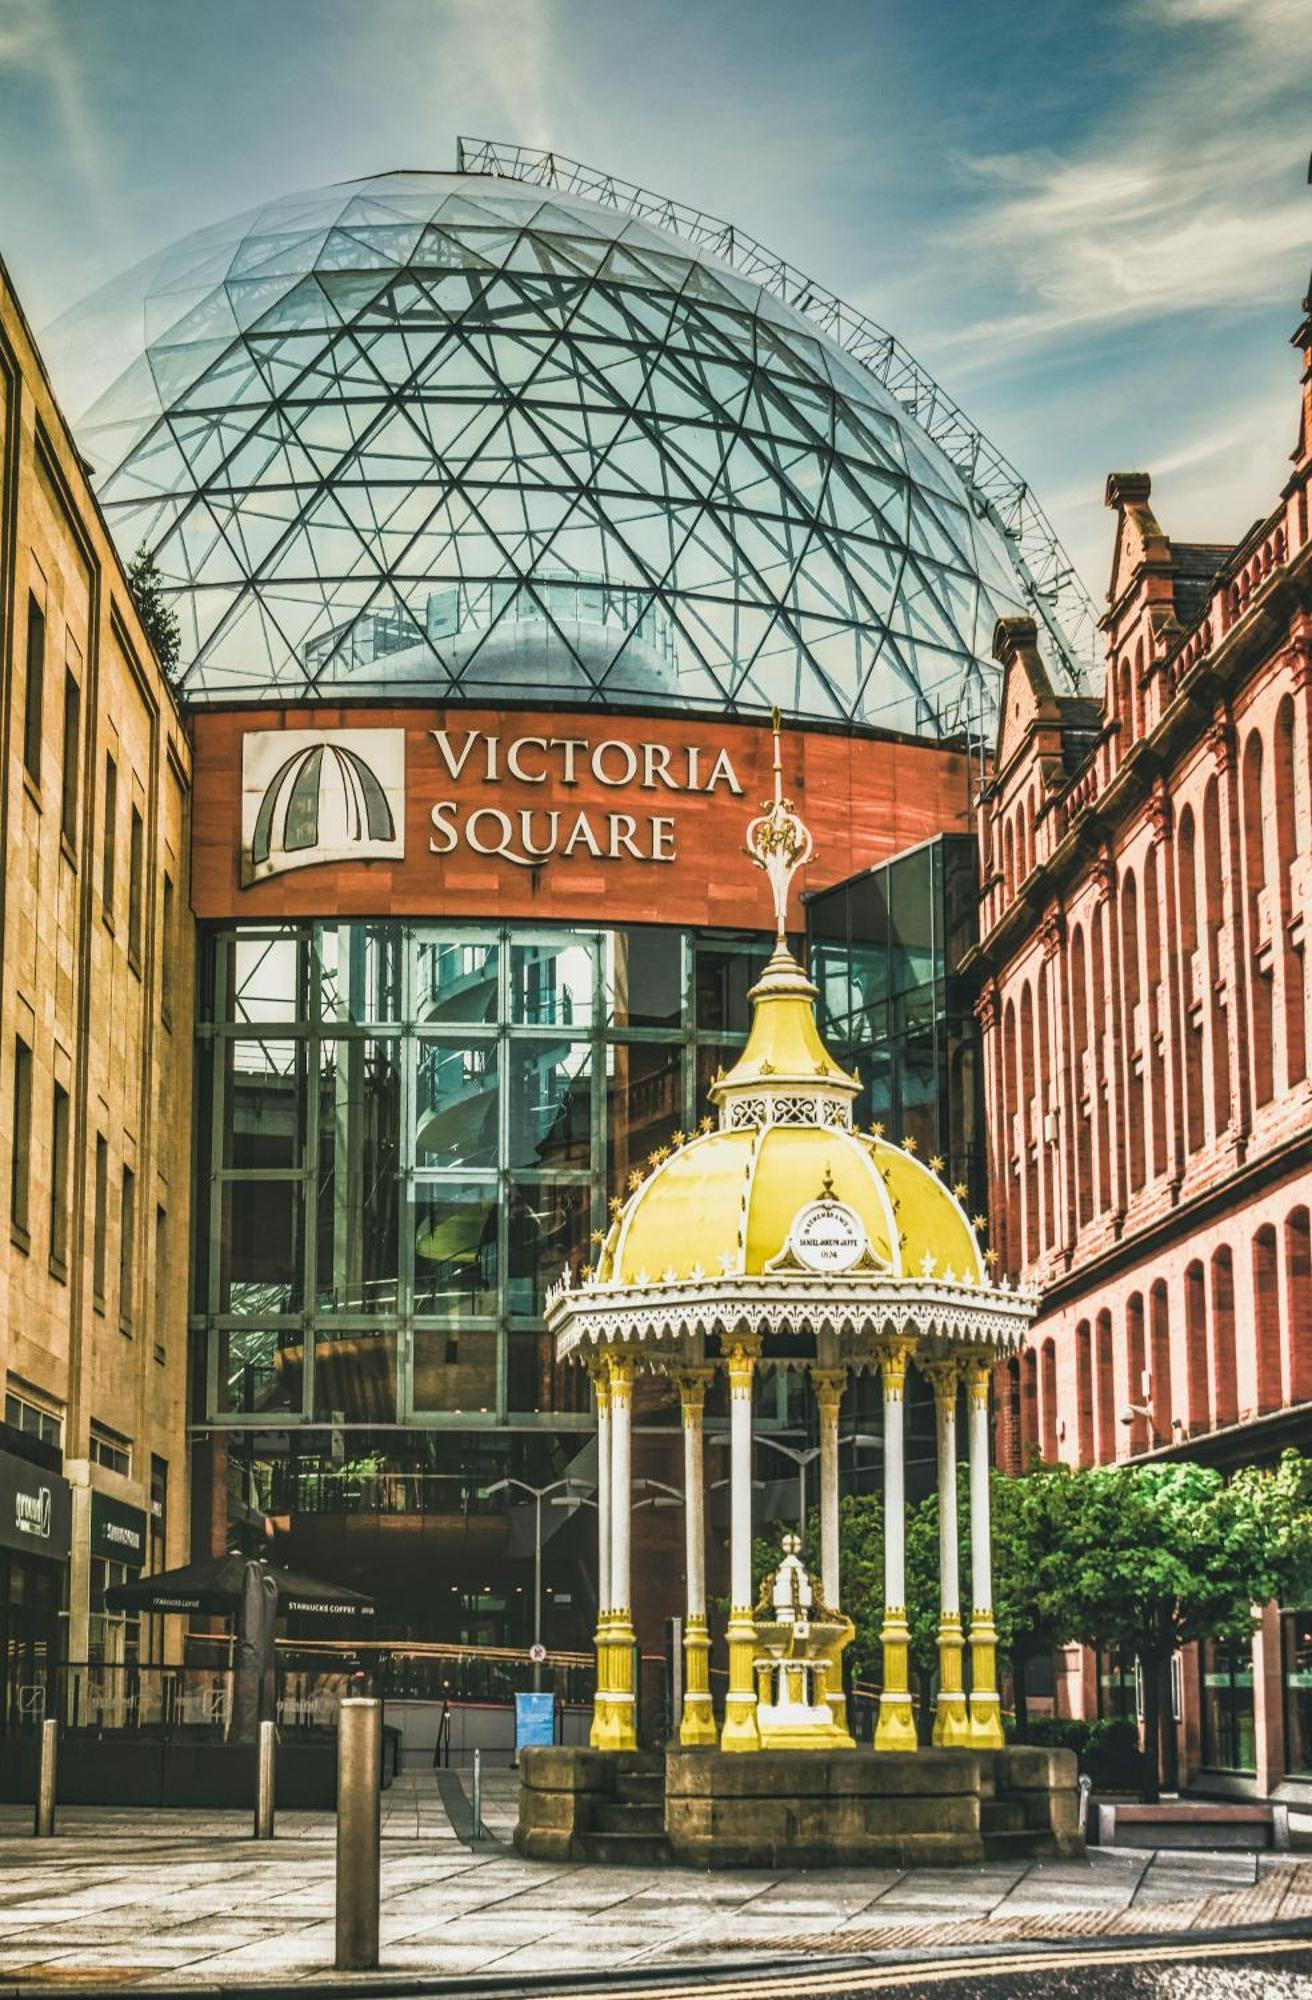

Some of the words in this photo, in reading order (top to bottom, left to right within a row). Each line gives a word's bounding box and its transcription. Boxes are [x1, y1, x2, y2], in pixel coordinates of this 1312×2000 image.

[429, 728, 744, 795] VICTORIA
[429, 802, 677, 866] SQUARE
[288, 1601, 329, 1613] STARBUCKS
